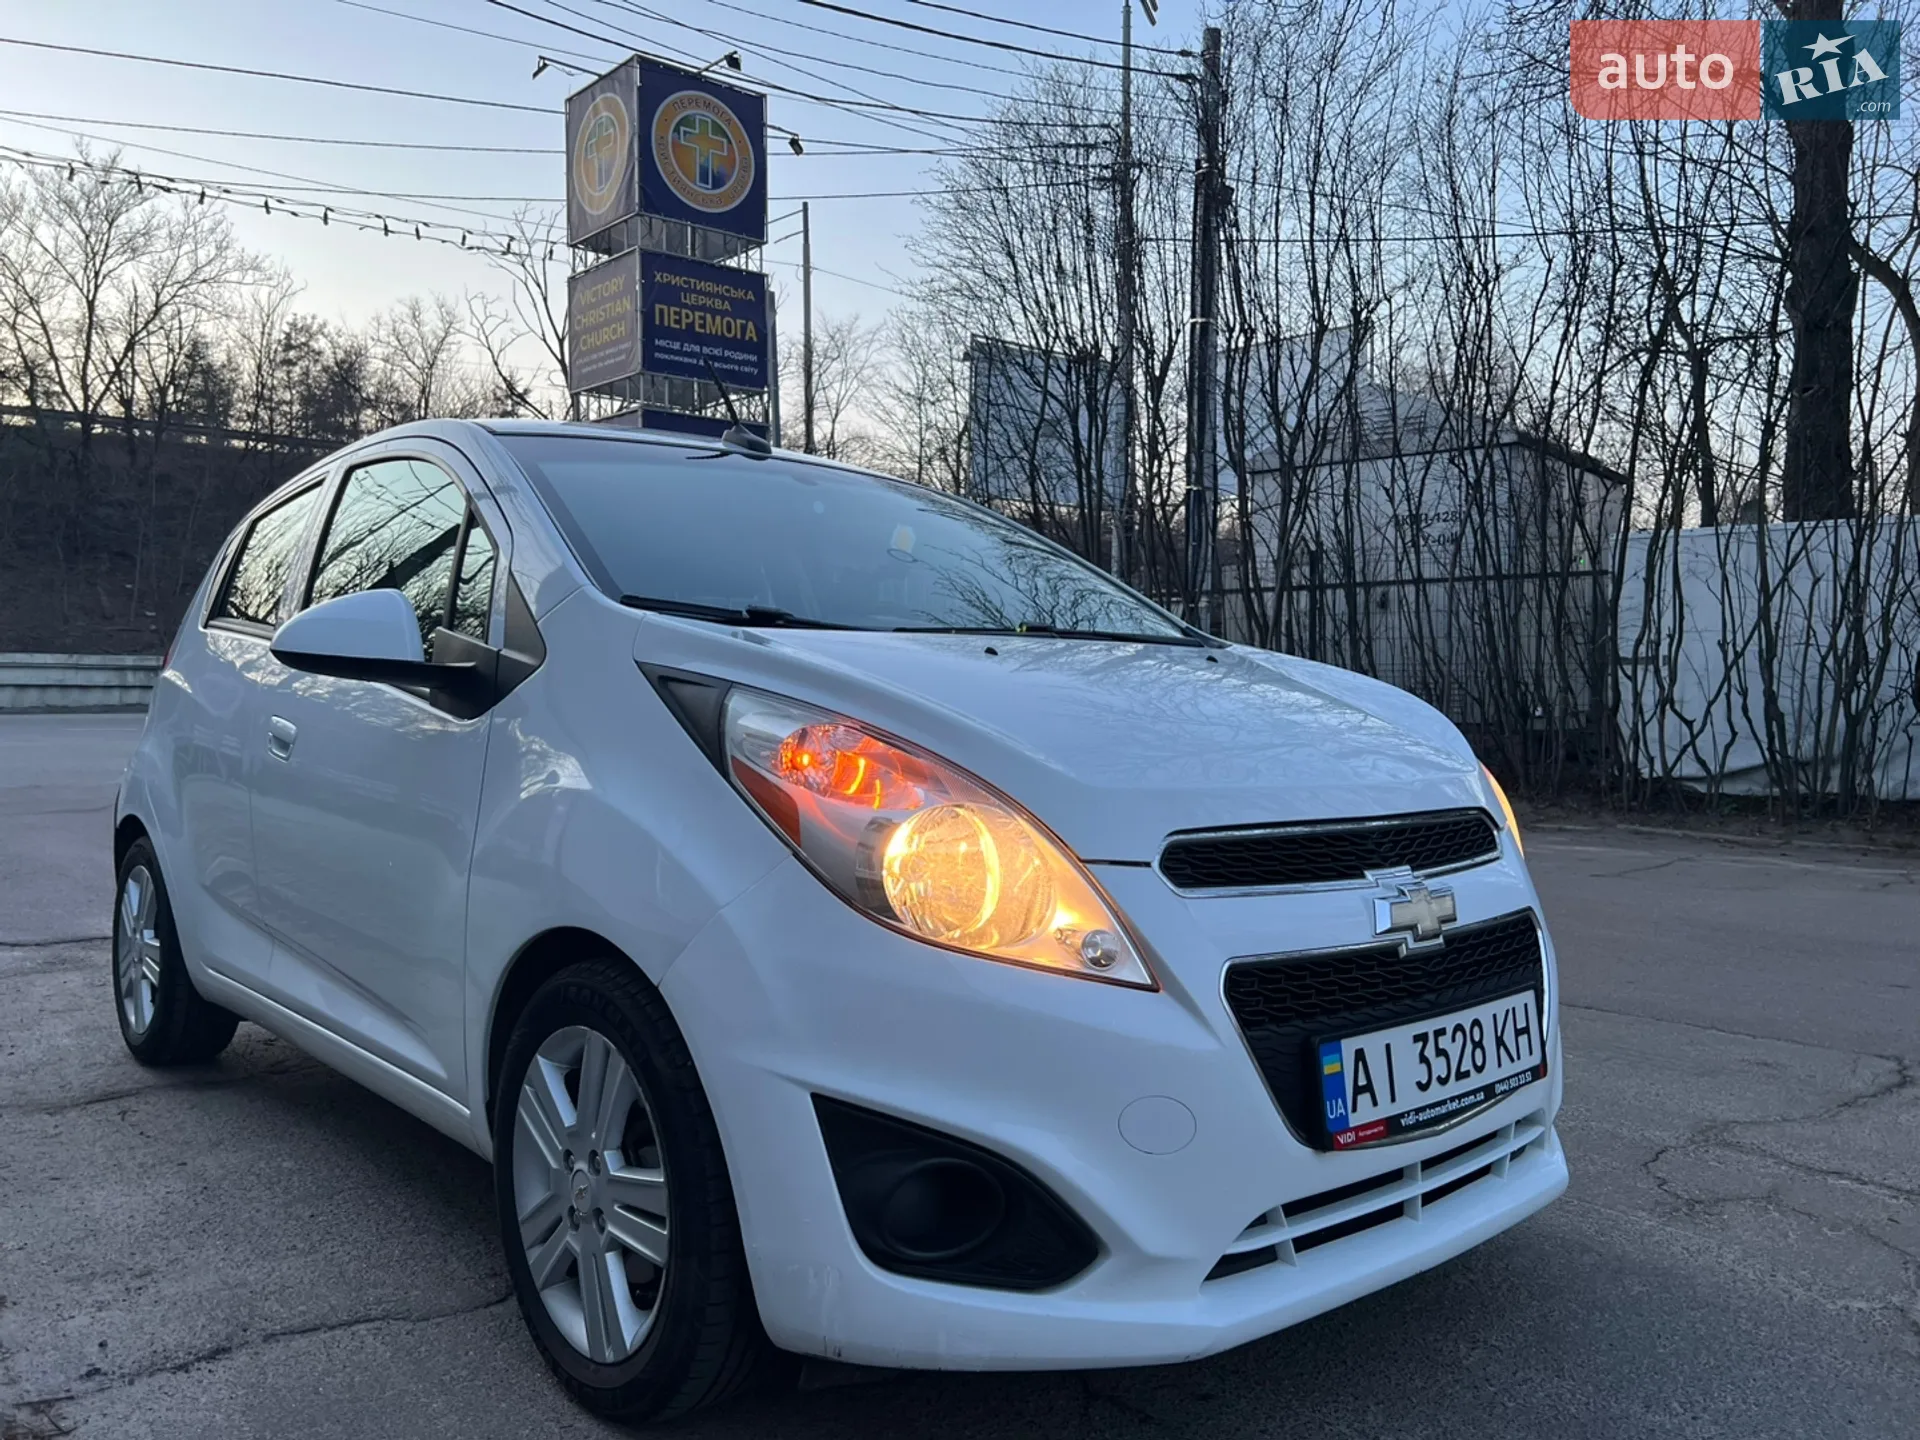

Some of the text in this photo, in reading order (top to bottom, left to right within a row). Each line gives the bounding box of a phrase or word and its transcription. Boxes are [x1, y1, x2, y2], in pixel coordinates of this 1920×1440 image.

[672, 98, 732, 126] ПЕРЕМОГА
[580, 274, 626, 305] VICTORY
[654, 271, 755, 301] ХРИСТИЯНСЬКА
[575, 295, 631, 330] CHRISTIAN
[681, 292, 732, 312] ЦЕРКВА
[580, 320, 626, 351] CHURCH
[655, 304, 758, 342] ПЕРЕМОГА
[682, 343, 700, 353] ДЛЯ
[724, 349, 757, 362] РОДИНИ
[714, 361, 738, 372] всього
[740, 364, 759, 376] світу
[1351, 1002, 1533, 1114] AI 3528 KH
[1326, 1098, 1346, 1119] UA
[1400, 1091, 1485, 1127] vidi-automarket.com.ua
[1337, 1130, 1356, 1144] VIDI
